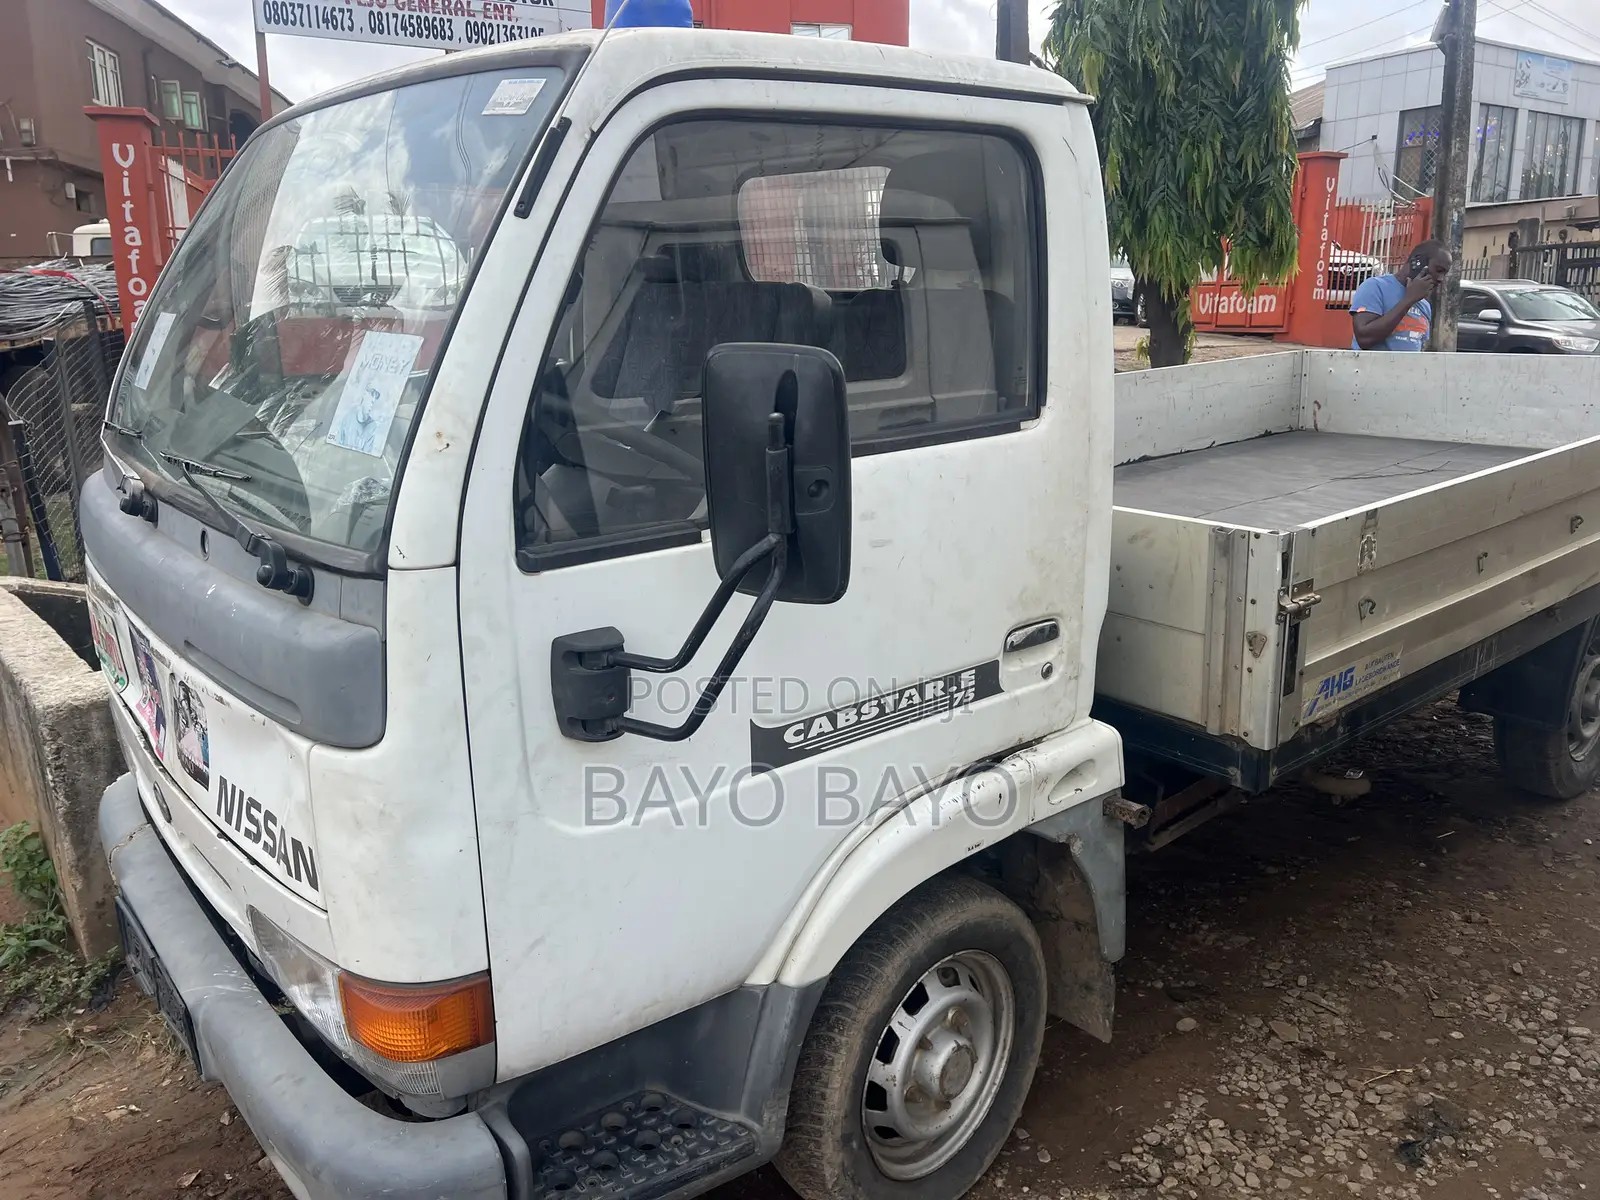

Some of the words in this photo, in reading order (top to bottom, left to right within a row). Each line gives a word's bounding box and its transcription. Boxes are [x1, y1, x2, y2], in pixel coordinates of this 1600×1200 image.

[394, 0, 476, 17] GENERAL
[111, 143, 147, 333] Vitafoa
[1313, 177, 1336, 300] Vitafoam
[1199, 291, 1277, 315] Vitafoam
[952, 687, 976, 707] 75
[216, 774, 320, 893] NISSAN
